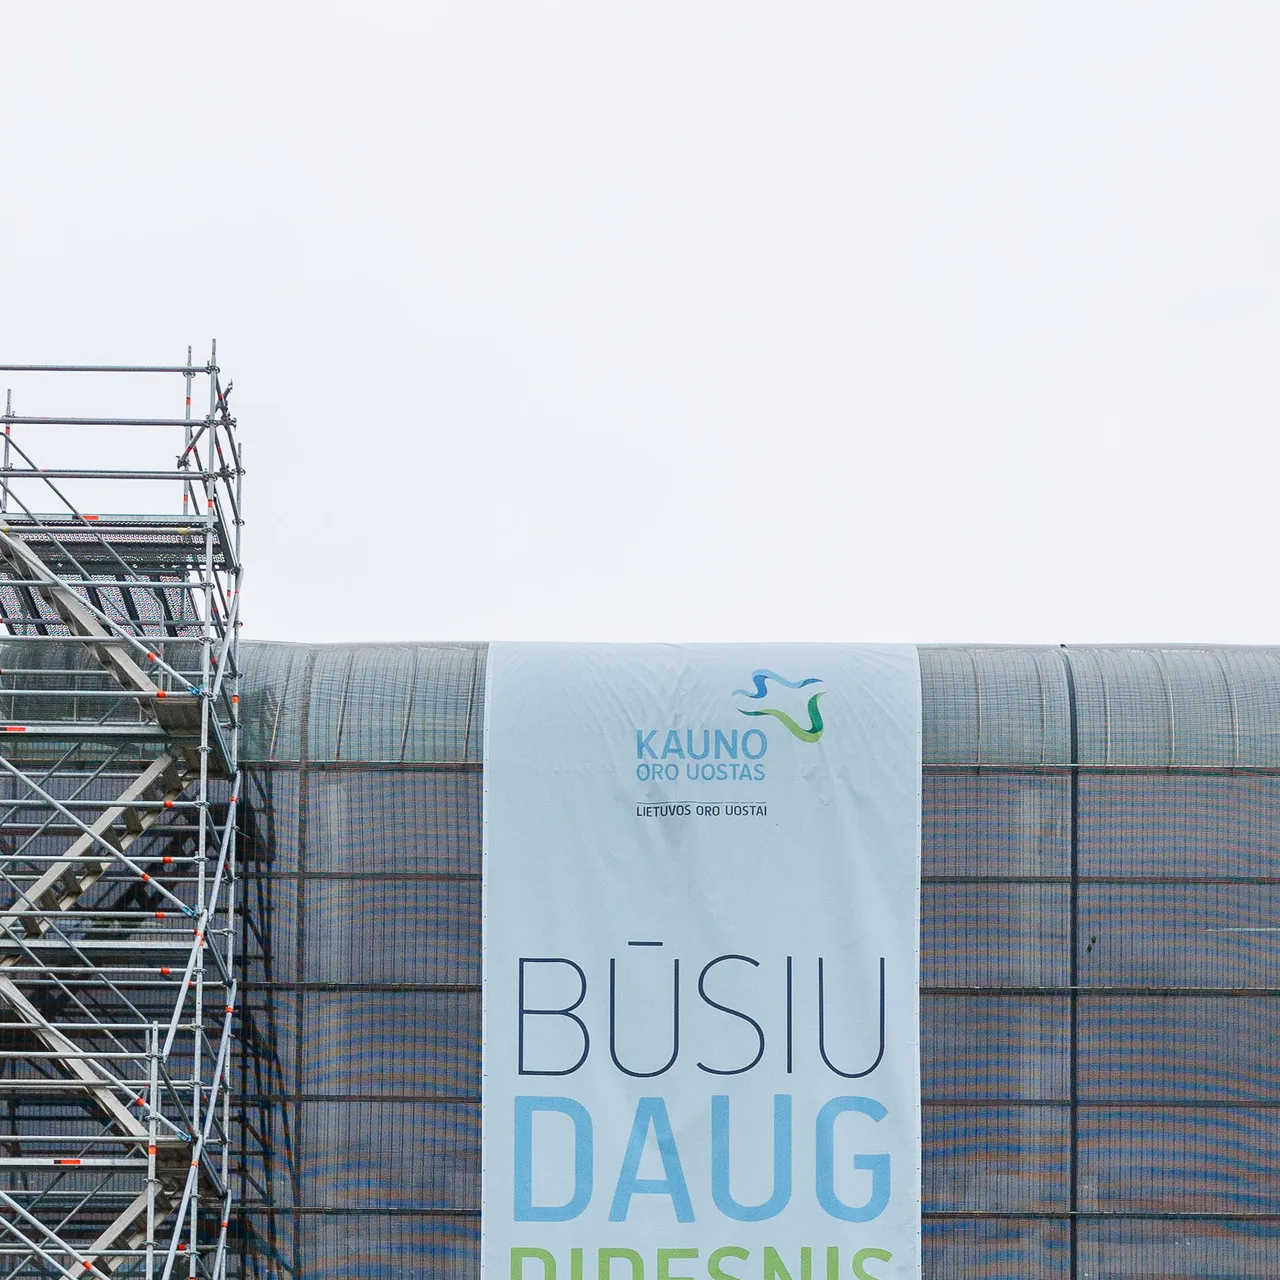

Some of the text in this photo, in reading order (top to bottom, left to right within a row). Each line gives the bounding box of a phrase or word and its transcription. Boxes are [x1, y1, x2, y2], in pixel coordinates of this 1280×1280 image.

[637, 729, 767, 760] KAUNO
[637, 763, 766, 781] ORO UOSTAS
[636, 805, 767, 817] LIETUVOS ORO UOSTAI
[519, 941, 885, 1078] BŪSIU
[514, 1094, 891, 1223] DAUG
